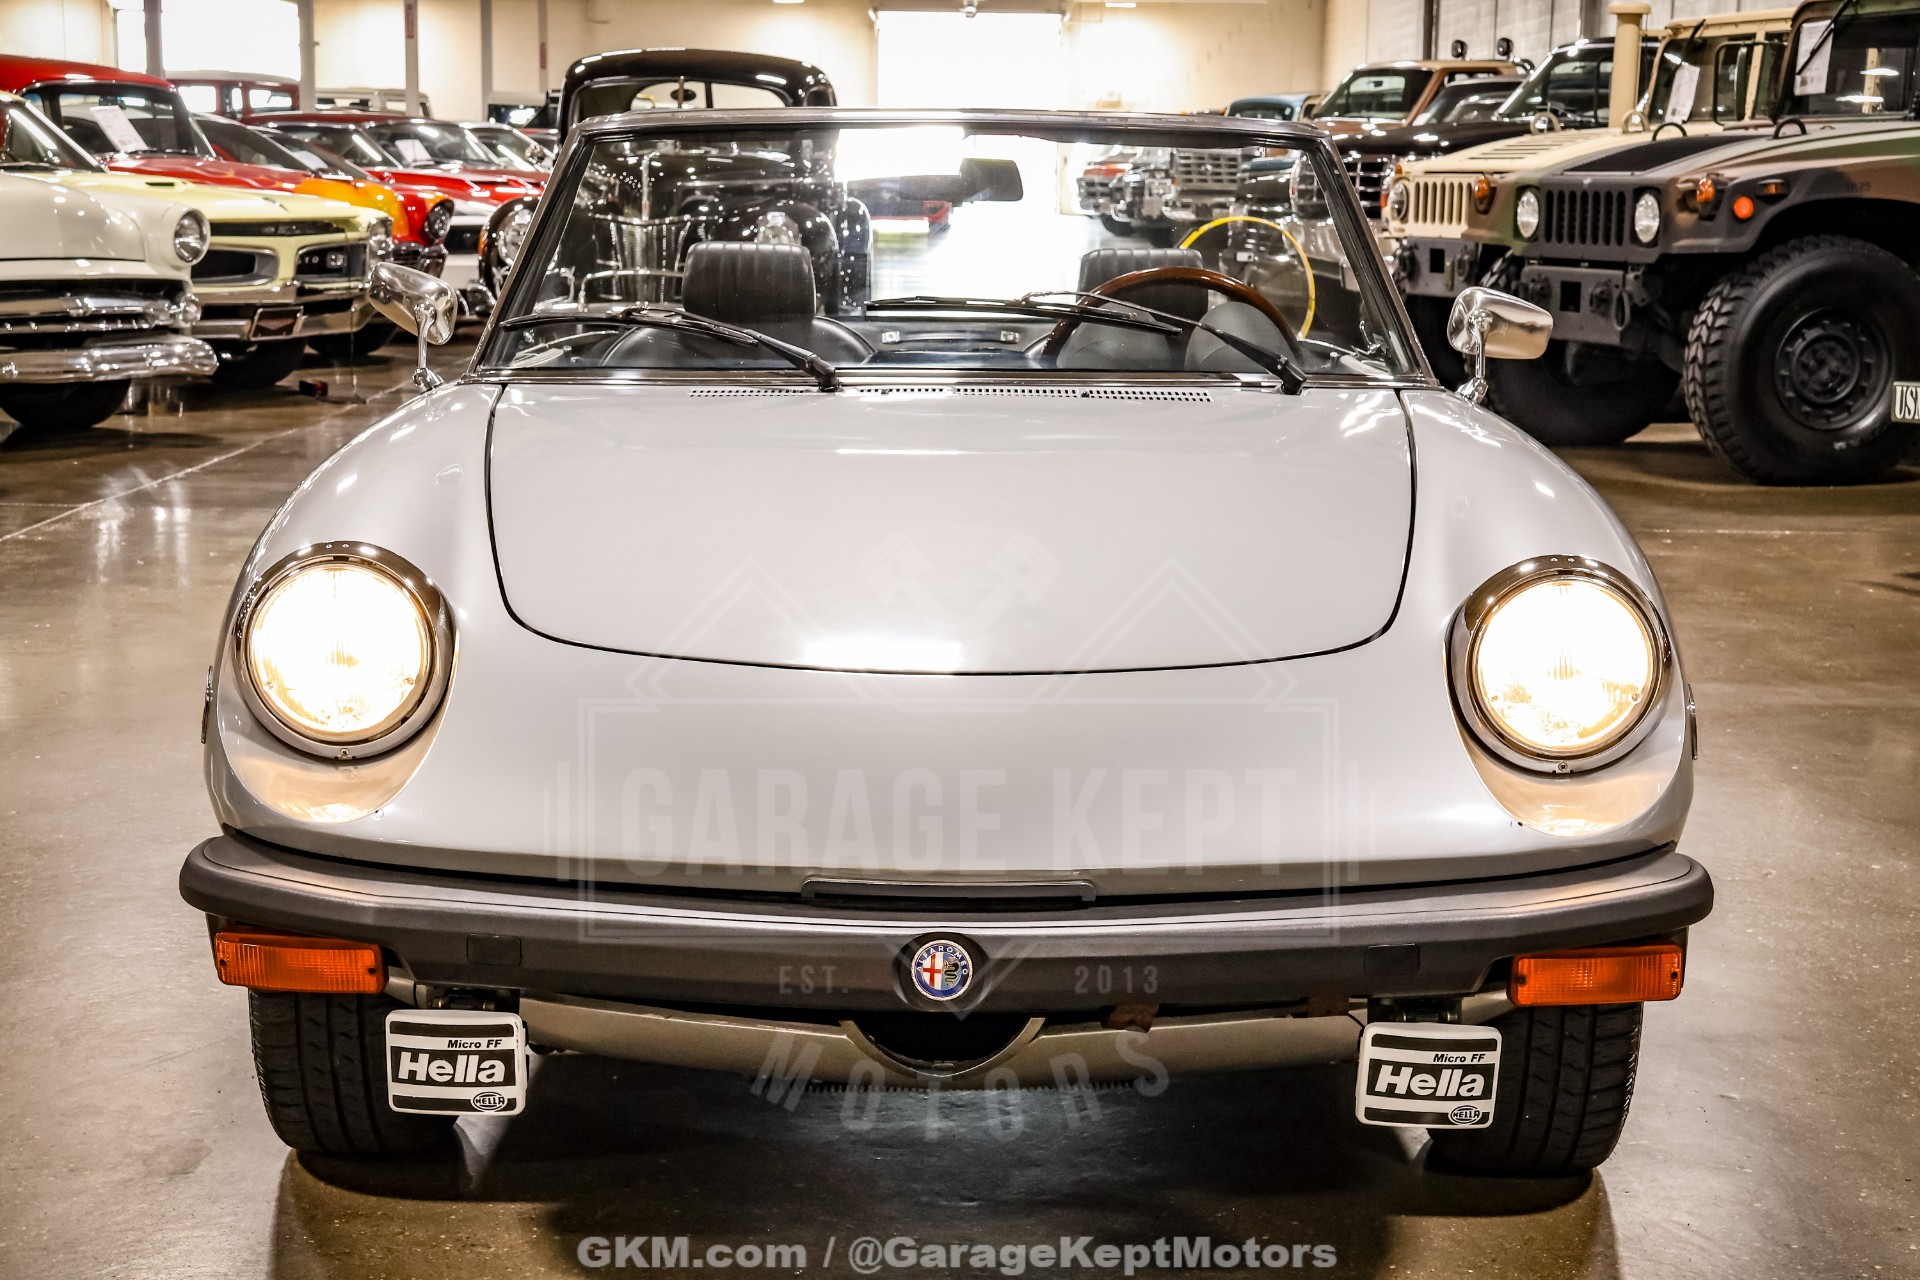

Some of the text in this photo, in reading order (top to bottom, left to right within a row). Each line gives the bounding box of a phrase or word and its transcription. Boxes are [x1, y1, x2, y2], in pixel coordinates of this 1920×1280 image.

[447, 1038, 503, 1049] Micro FF
[1432, 1053, 1486, 1063] Micro FF
[398, 1051, 506, 1083] Hella
[1374, 1064, 1485, 1097] Hella
[474, 1096, 505, 1106] HELLA
[1452, 1110, 1480, 1119] HELLA
